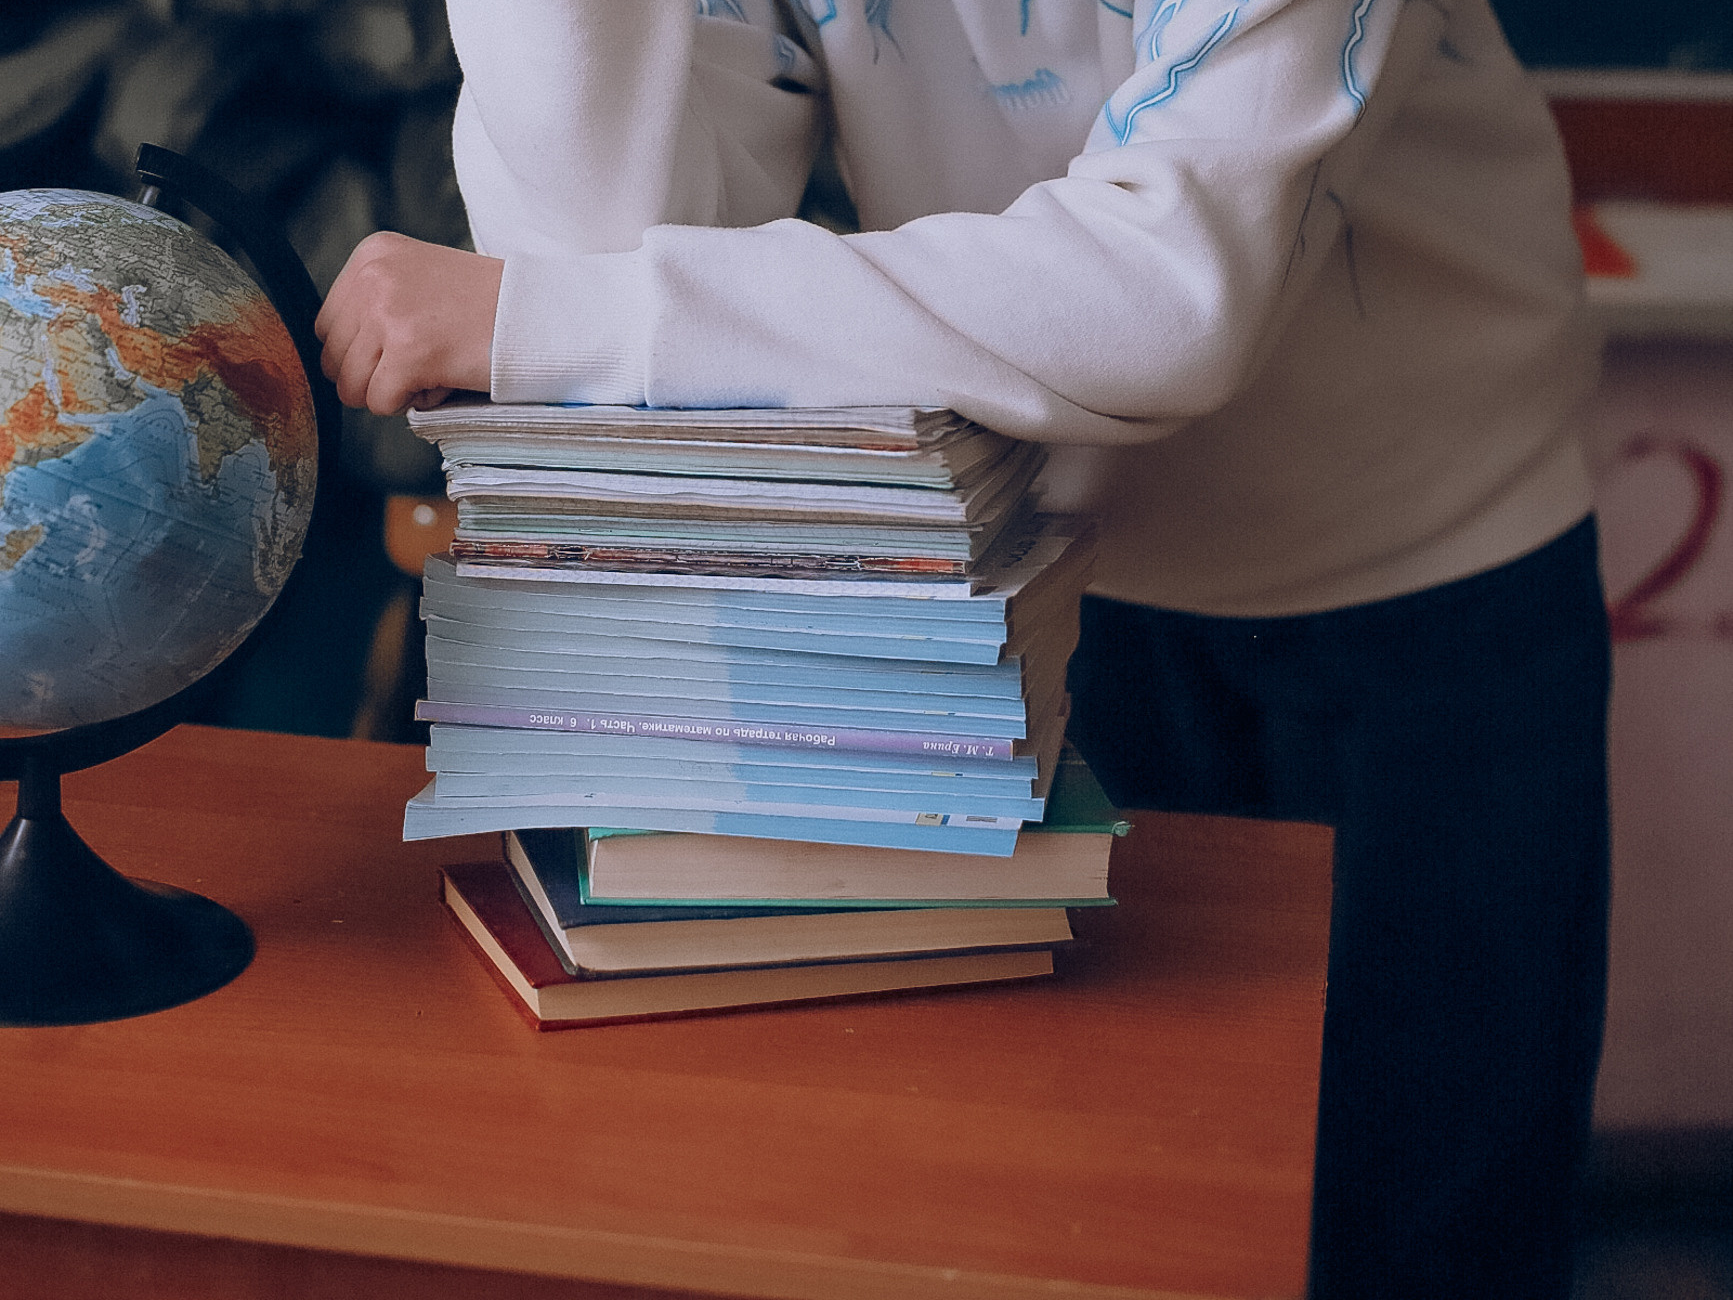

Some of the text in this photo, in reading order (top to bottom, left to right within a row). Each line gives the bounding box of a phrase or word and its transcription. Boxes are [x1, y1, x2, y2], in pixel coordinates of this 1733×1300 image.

[529, 714, 564, 726] класс
[570, 717, 577, 727] 6
[586, 718, 597, 729] 1.
[600, 719, 636, 733] Часть
[638, 722, 712, 736] математике.
[715, 726, 730, 736] по
[733, 727, 782, 741] тетрадь
[784, 732, 836, 746] Рабочая
[963, 744, 979, 755] М.
